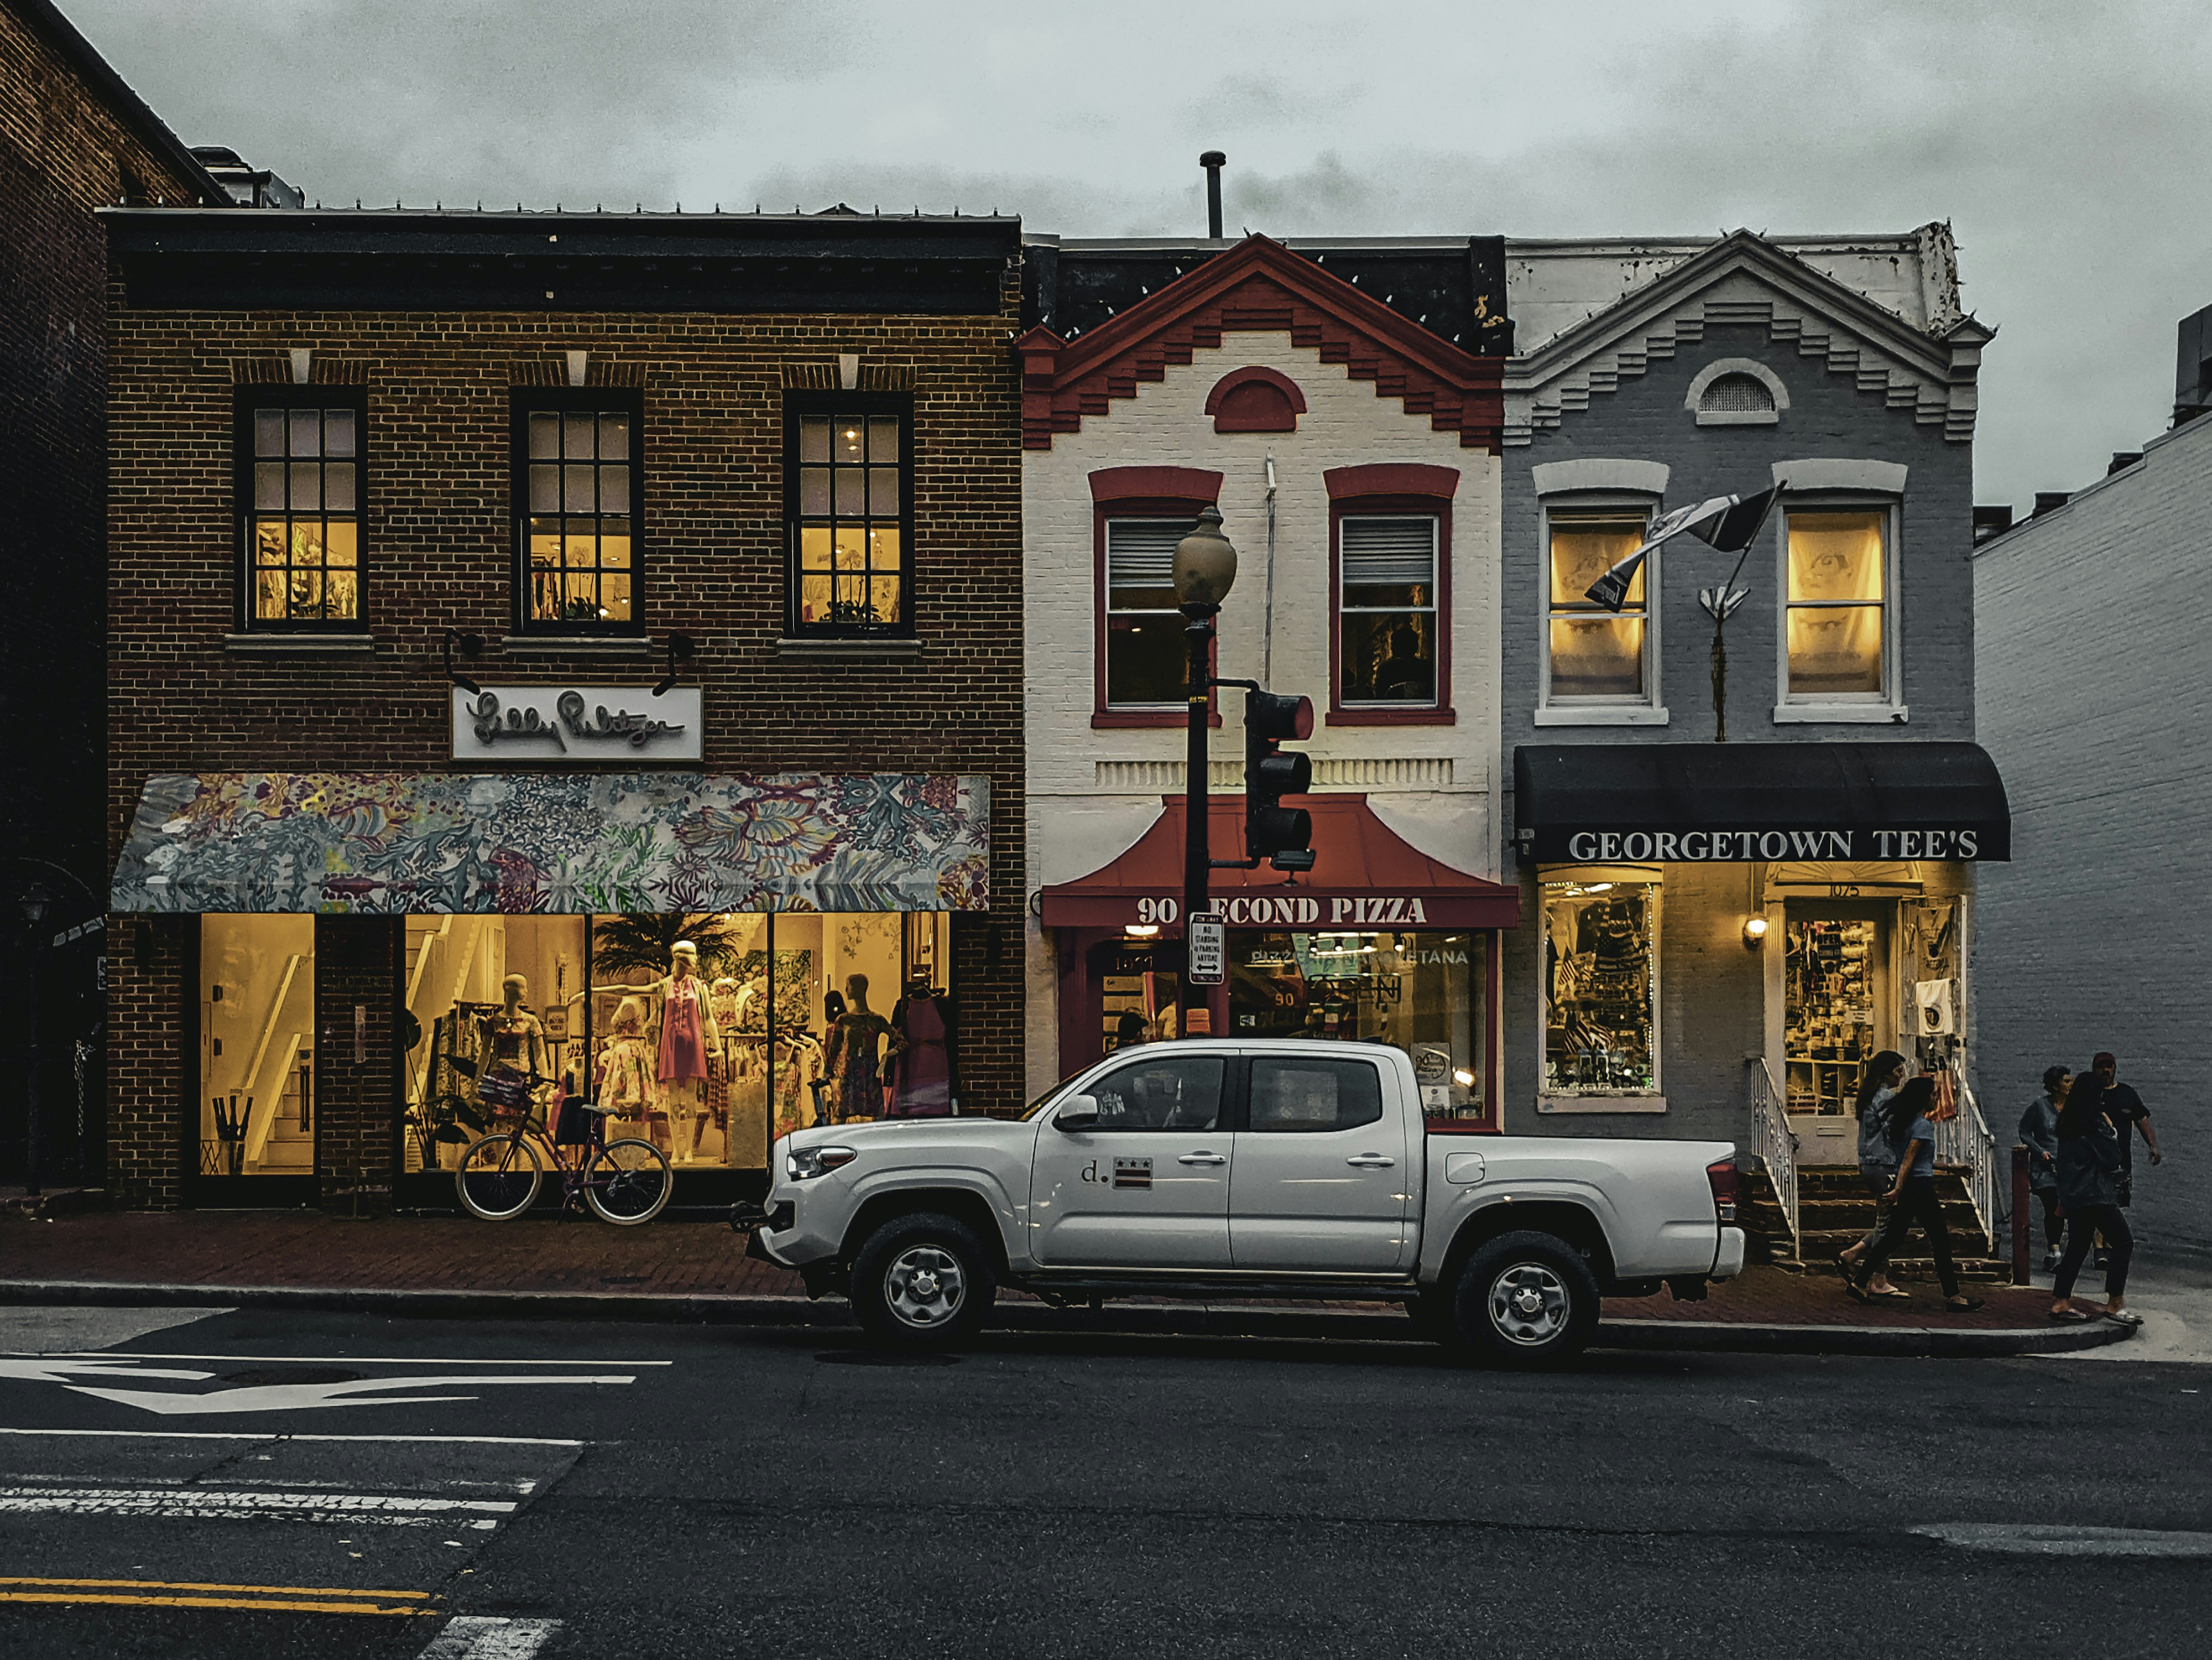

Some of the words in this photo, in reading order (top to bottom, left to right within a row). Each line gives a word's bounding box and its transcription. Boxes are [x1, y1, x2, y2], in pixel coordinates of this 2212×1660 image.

[465, 691, 567, 753] Lilly
[1569, 831, 1853, 860] GEORGETOWN
[1872, 830, 1978, 860] TEE'S
[1830, 885, 1859, 897] 1075
[1138, 897, 1177, 923] 90
[1209, 897, 1319, 923] ECOND
[1330, 897, 1427, 923] PIZZA
[1275, 992, 1293, 1006] 90
